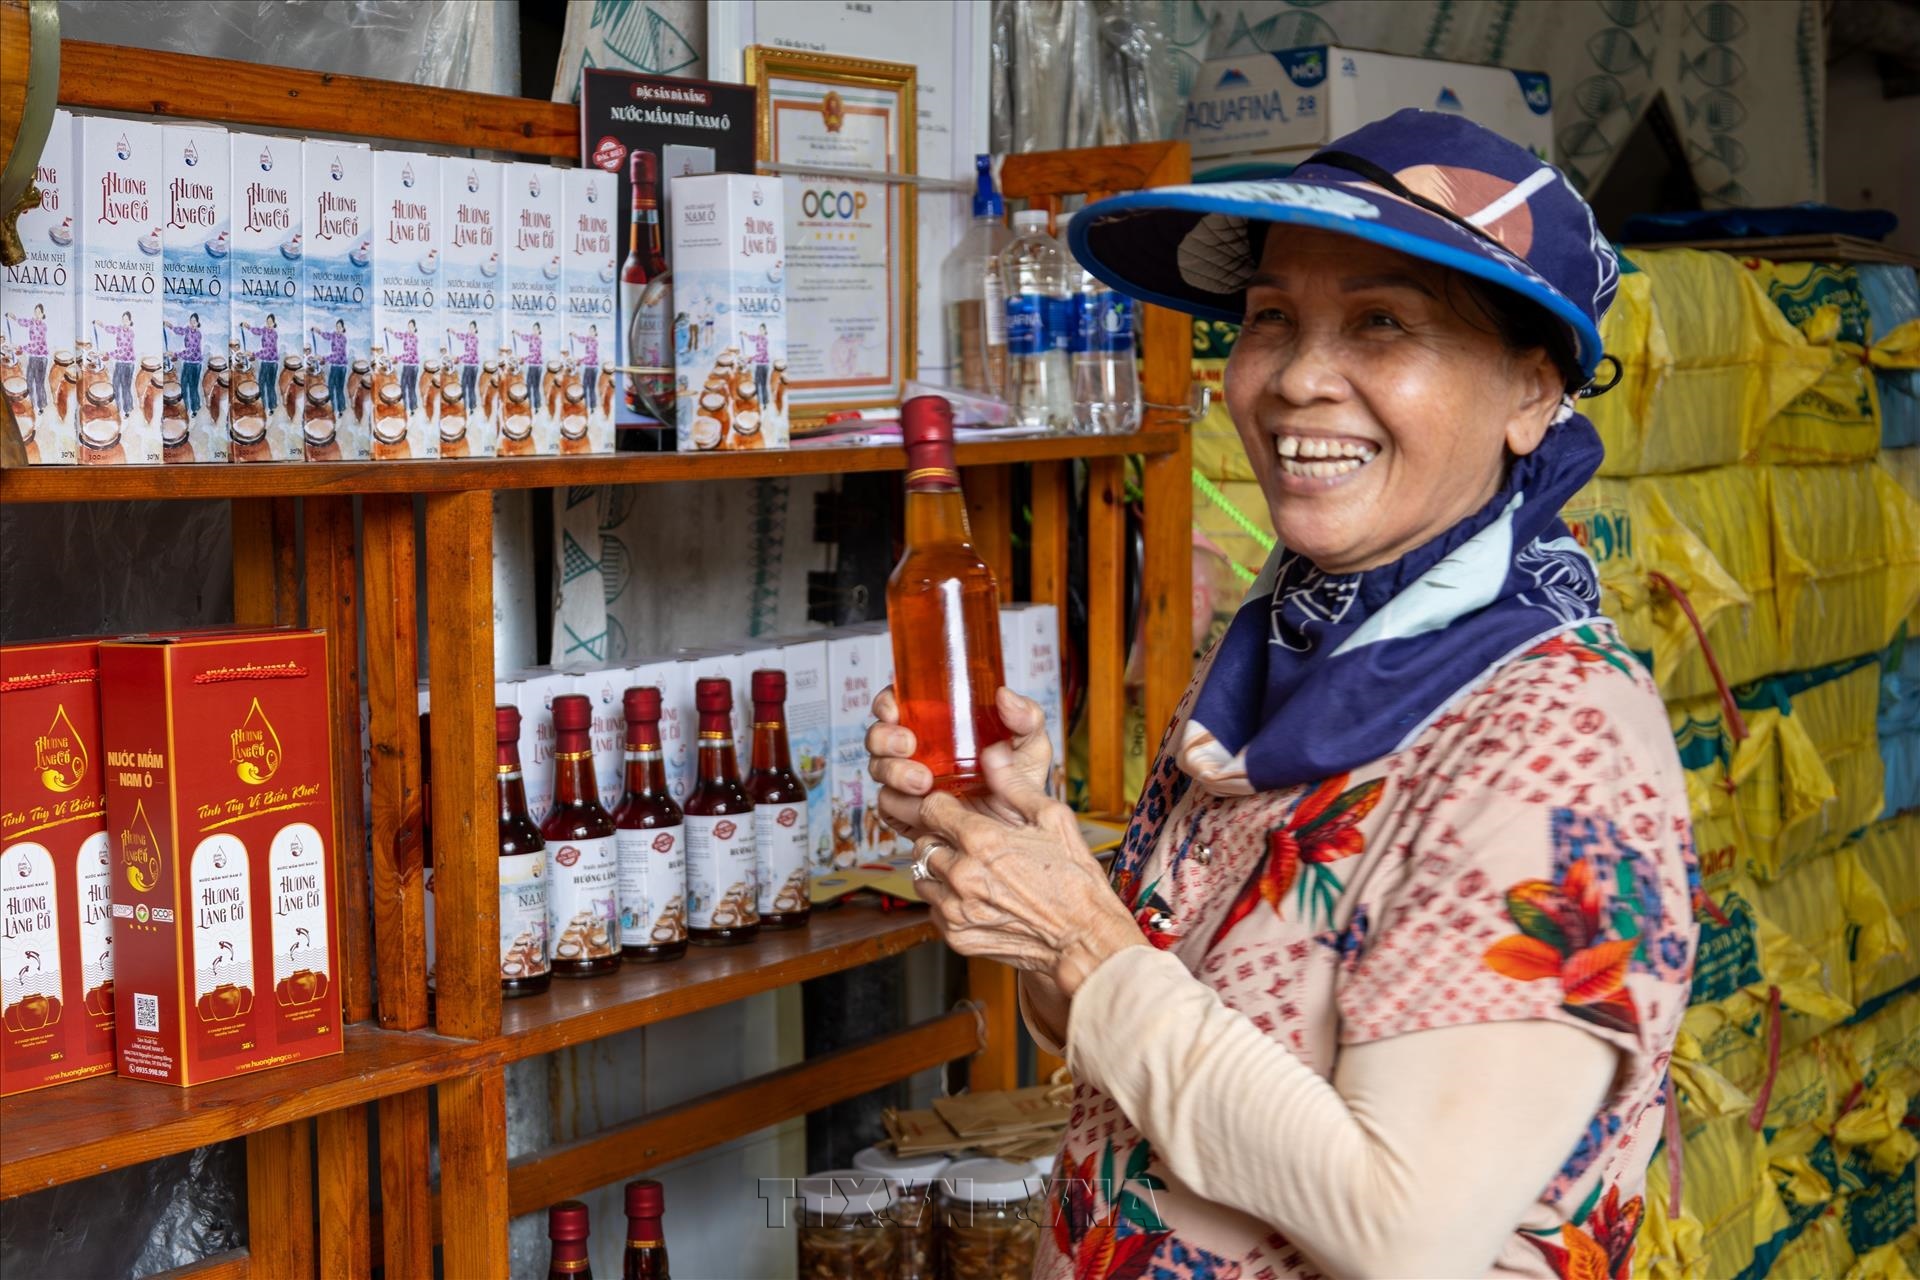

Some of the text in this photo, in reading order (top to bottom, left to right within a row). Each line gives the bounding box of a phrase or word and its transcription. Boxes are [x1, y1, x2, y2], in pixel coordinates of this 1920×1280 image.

[610, 104, 730, 130] NƯỚC MẮM NHĨ NAM Ô
[1183, 88, 1291, 135] AQUAFINA
[36, 167, 57, 184] ƠNG
[102, 171, 146, 196] HƯƠNG
[169, 178, 213, 201] HƯƠNG
[247, 183, 287, 205] HƯƠNG
[318, 191, 356, 213] HƯƠNG
[802, 189, 868, 219] OCOP
[7, 263, 67, 286] NAM Ô
[95, 260, 117, 269] NƯỚC
[163, 263, 185, 272] NƯỚC
[95, 273, 155, 294] NAM Ô
[163, 275, 221, 297] NAM Ô
[242, 277, 296, 297] NAM Ô
[313, 283, 364, 303] NAM Ô
[383, 288, 434, 308] NAM Ô
[448, 289, 495, 310] NAM Ô
[512, 292, 557, 314] NAM Ô
[107, 748, 163, 769] NƯỚC MẮM
[120, 771, 152, 788] NAM Ô
[88, 884, 111, 902] HƯƠ
[280, 875, 315, 893] HƯƠNG
[7, 896, 46, 915] HƯƠNG
[202, 887, 240, 906] HƯƠNG
[276, 895, 303, 916] LÀNG
[2, 917, 33, 939] LÀNG
[196, 908, 226, 929] LÀNG
